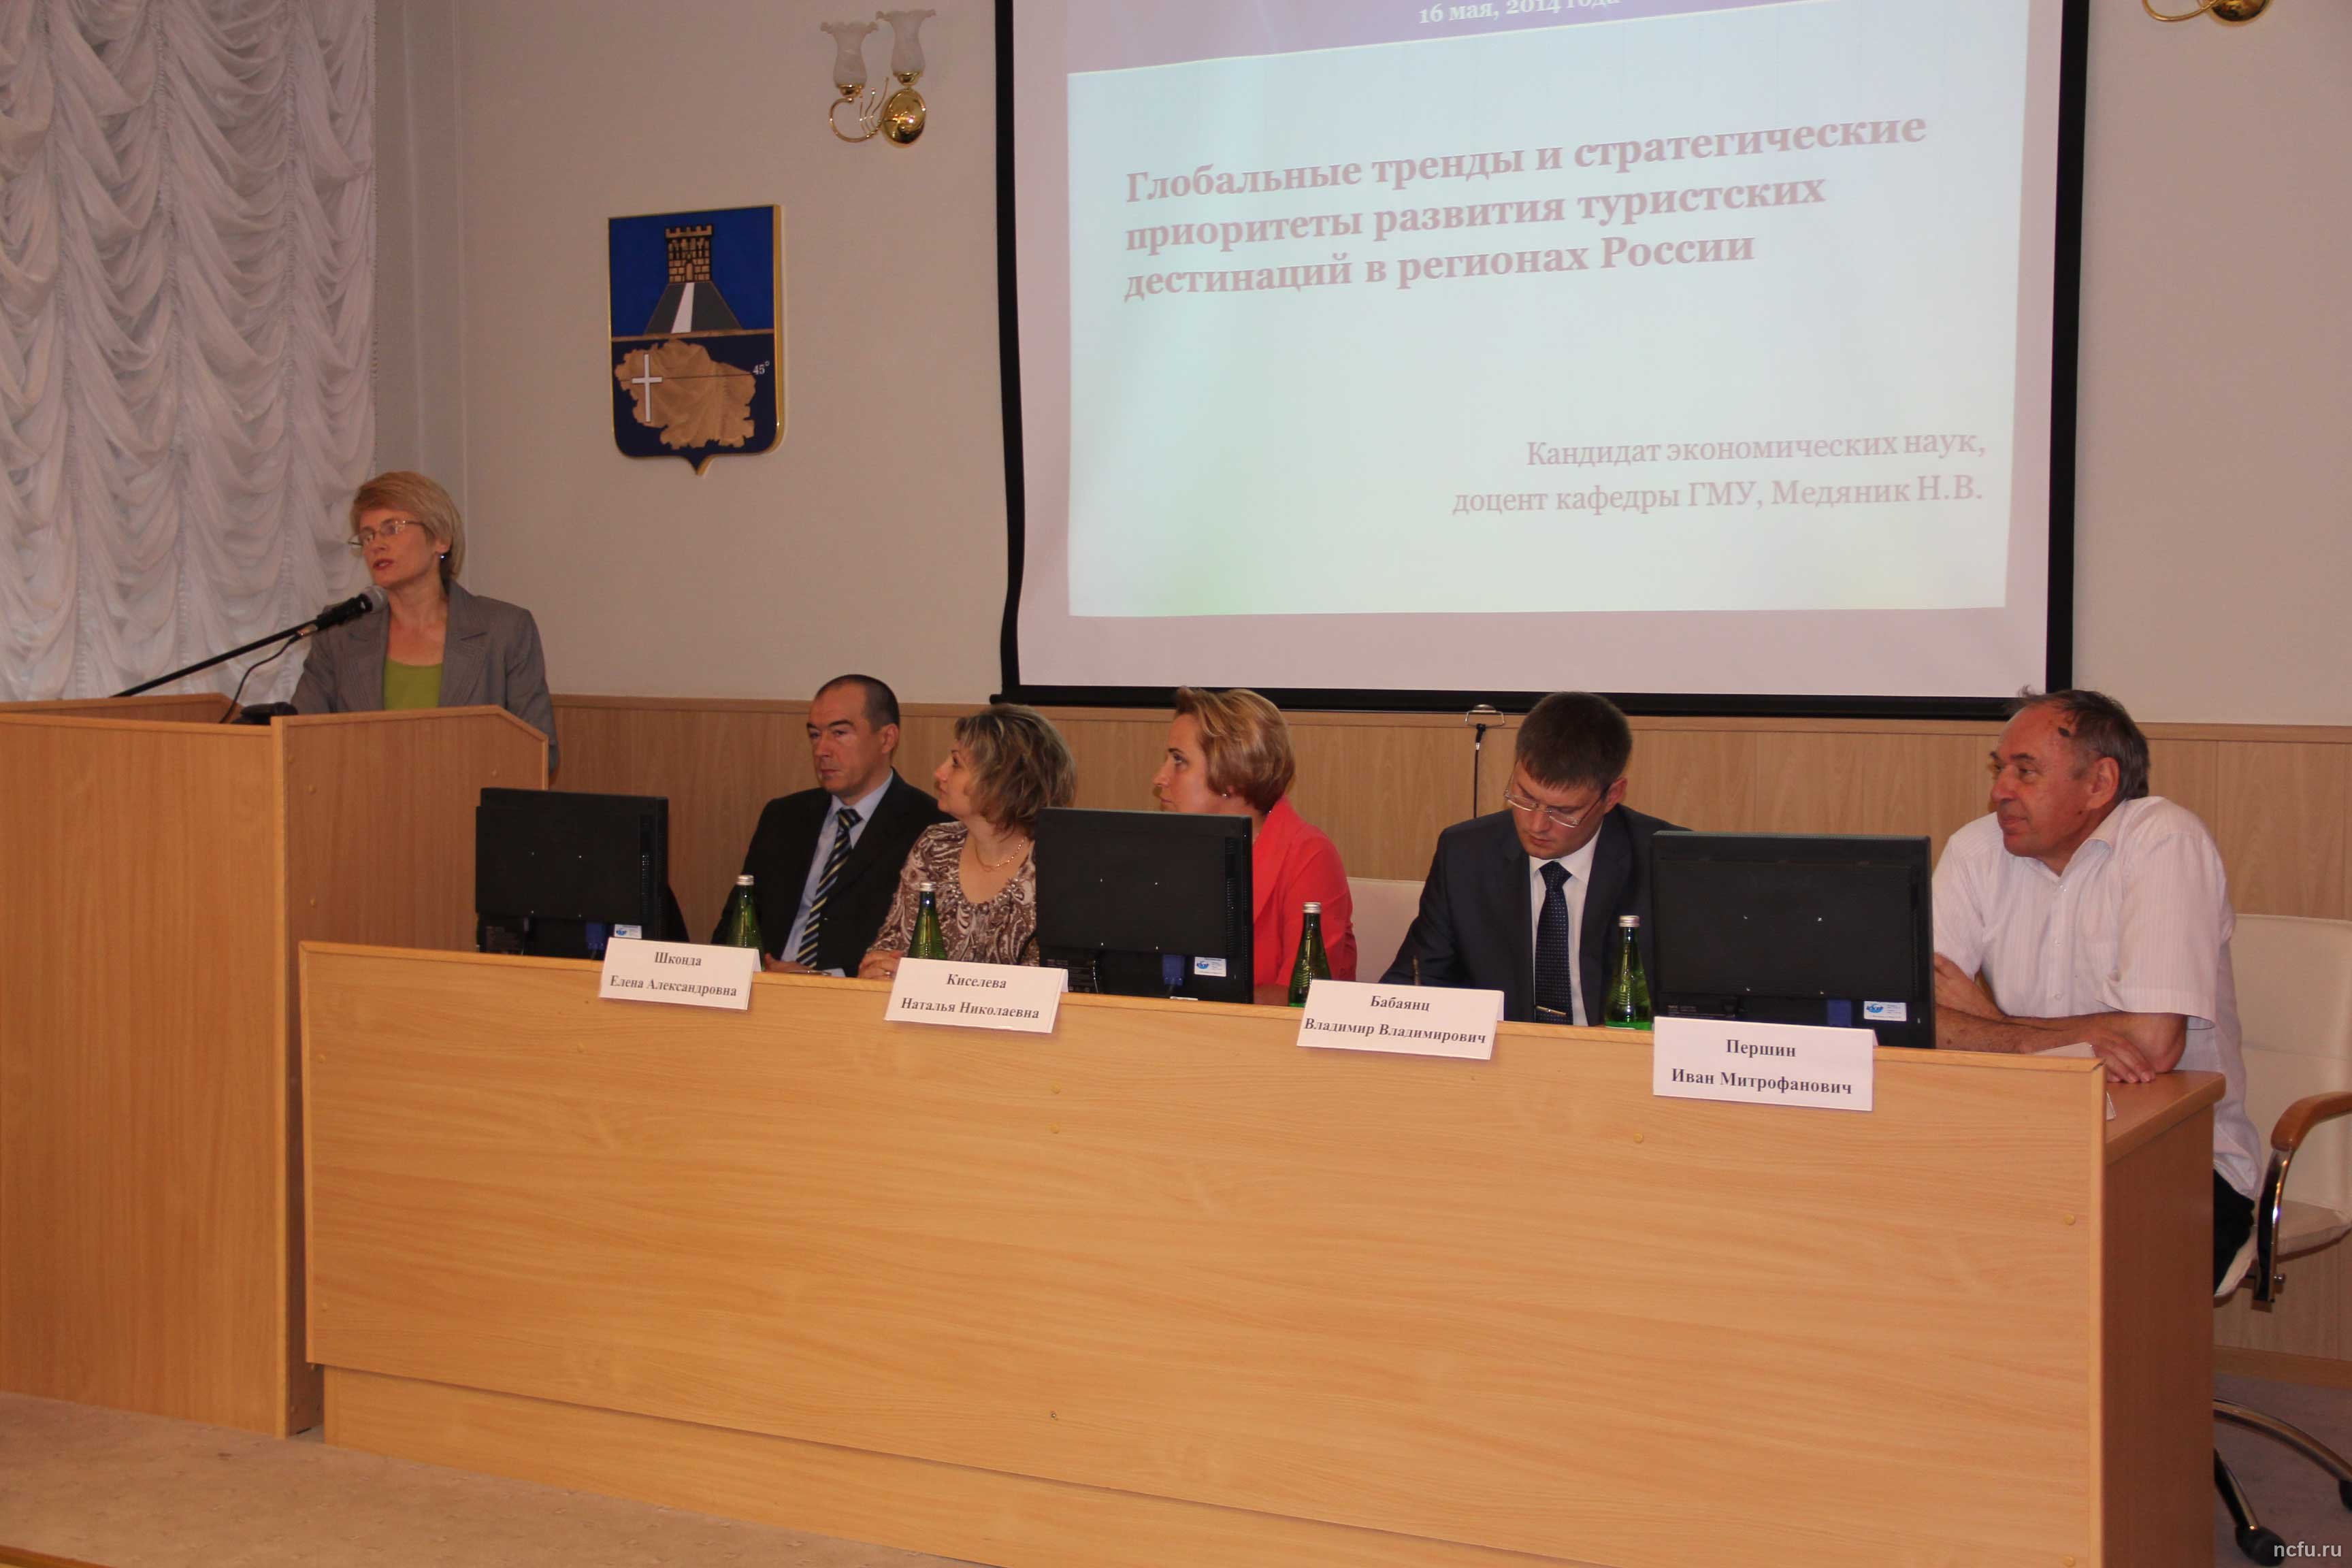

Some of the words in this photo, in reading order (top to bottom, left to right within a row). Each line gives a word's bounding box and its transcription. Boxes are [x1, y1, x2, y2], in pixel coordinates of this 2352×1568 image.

[1419, 5, 1443, 23] 16
[1449, 1, 1499, 21] мая,
[1126, 163, 1362, 203] Глобальные
[1371, 149, 1525, 191] тренды
[1535, 146, 1563, 171] и
[1574, 117, 1927, 174] стратегические
[1126, 212, 1362, 255] приоритеты
[1373, 199, 1565, 242] развития
[1578, 178, 1826, 227] туристских
[1124, 252, 1352, 303] дестинаций
[1365, 260, 1387, 282] в
[1397, 248, 1590, 290] регионах
[1601, 235, 1754, 269] России
[1526, 441, 1662, 468] Кандидат
[1667, 436, 1898, 461] экономических
[1904, 432, 1987, 459] наук,
[1452, 493, 1549, 515] доцент
[1556, 484, 1680, 517] кафедры
[1688, 480, 1765, 509] ГМУ,
[1771, 480, 1912, 508] Медяник
[1916, 474, 1983, 501] Н.В.
[653, 951, 702, 966] Шконда
[610, 975, 644, 989] Елена
[646, 979, 737, 996] Александровна
[946, 973, 1007, 989] Киселева
[900, 998, 956, 1013] Наталья
[959, 1002, 1040, 1019] Николаевна
[1369, 995, 1431, 1012] Бабаянц
[1304, 1017, 1375, 1037] Владимир
[1378, 1024, 1487, 1044] Владимирович
[1726, 1039, 1797, 1058] Першин
[1671, 1068, 1714, 1085] Иван
[1720, 1071, 1852, 1094] Митрофанович
